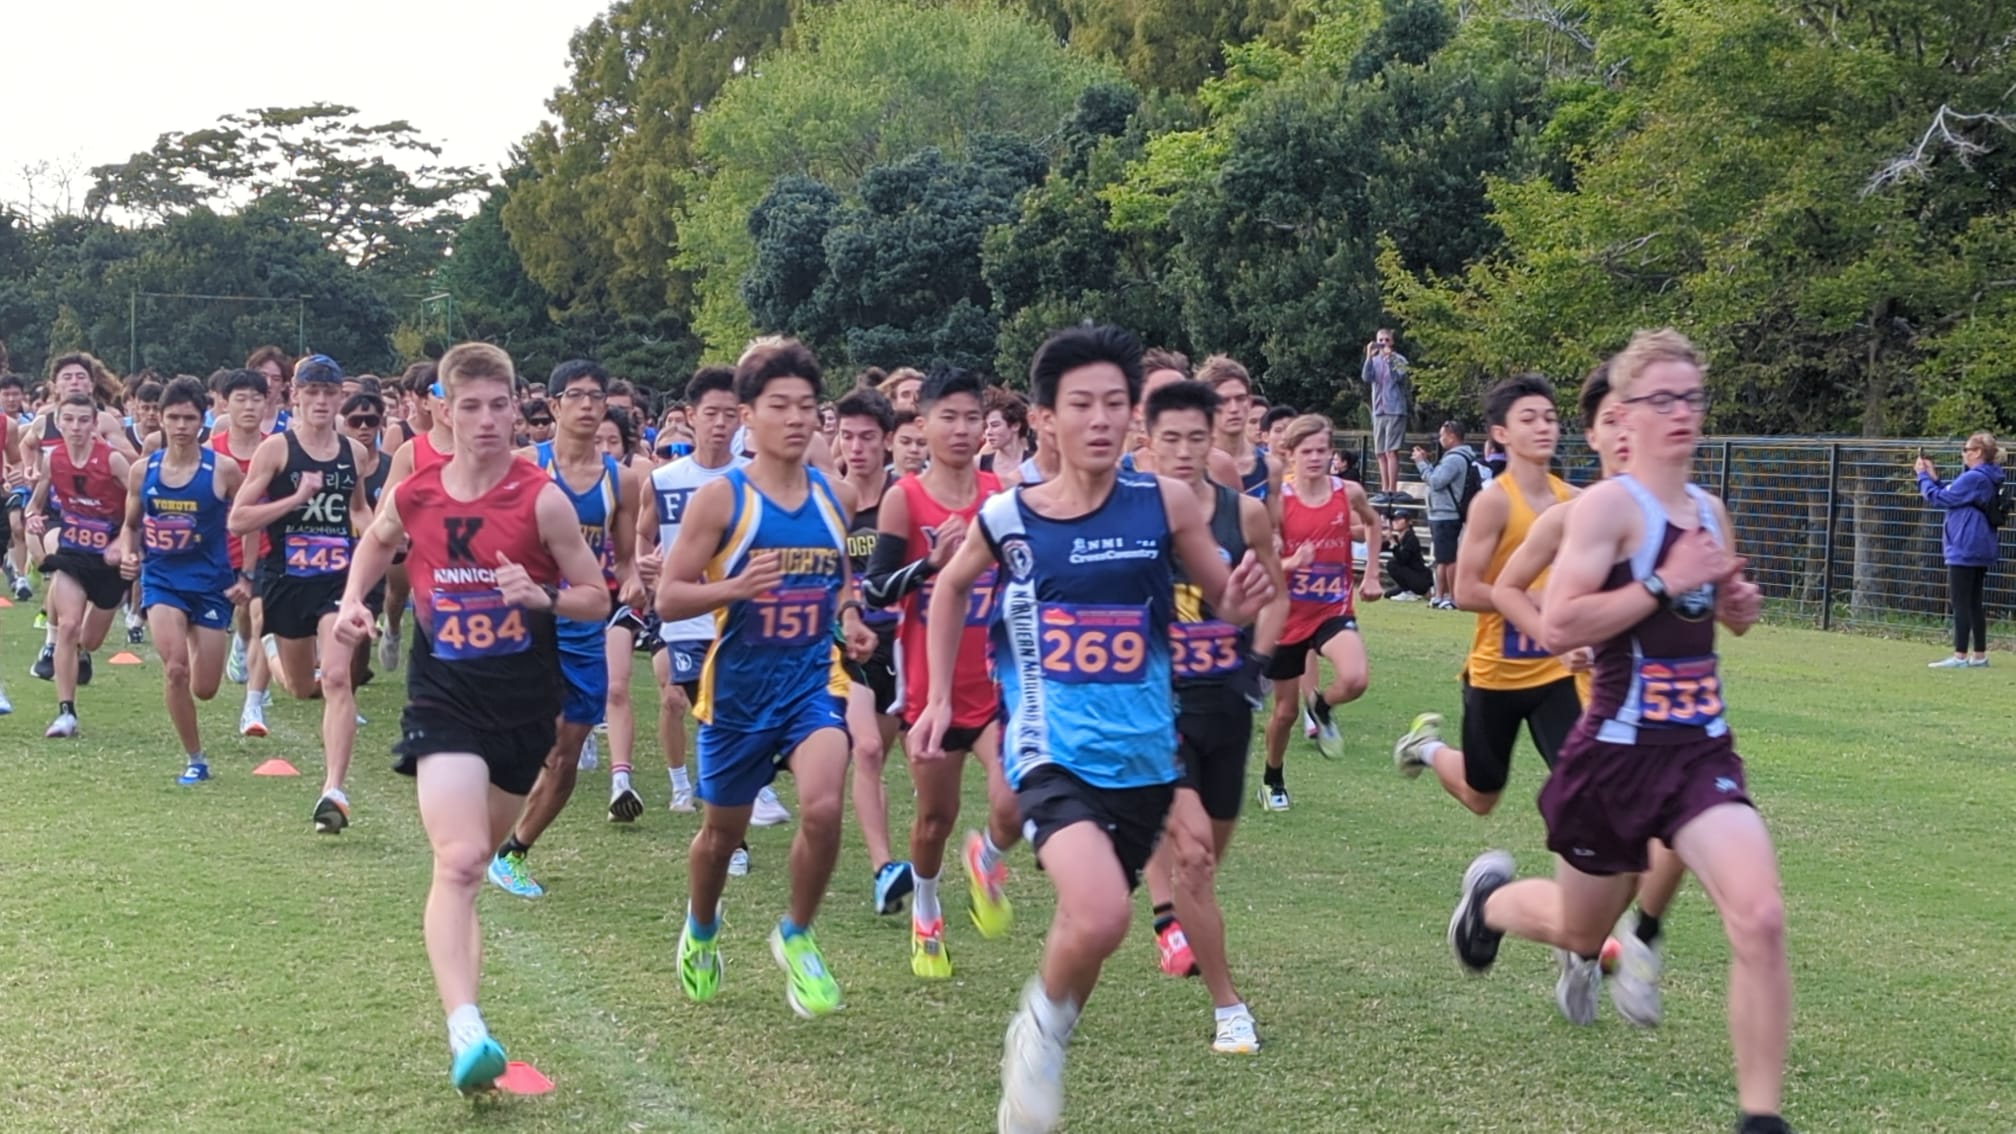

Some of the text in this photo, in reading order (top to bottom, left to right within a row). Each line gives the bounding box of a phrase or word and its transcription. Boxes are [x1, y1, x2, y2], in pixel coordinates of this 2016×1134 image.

[302, 492, 345, 522] XC
[64, 526, 107, 548] 489
[144, 528, 191, 550] 557
[444, 517, 483, 563] K
[288, 550, 349, 570] 445
[1293, 575, 1341, 597] 344
[438, 609, 525, 649] 484
[758, 604, 819, 638] 151
[1043, 629, 1145, 673] 269
[1643, 677, 1723, 721] 533
